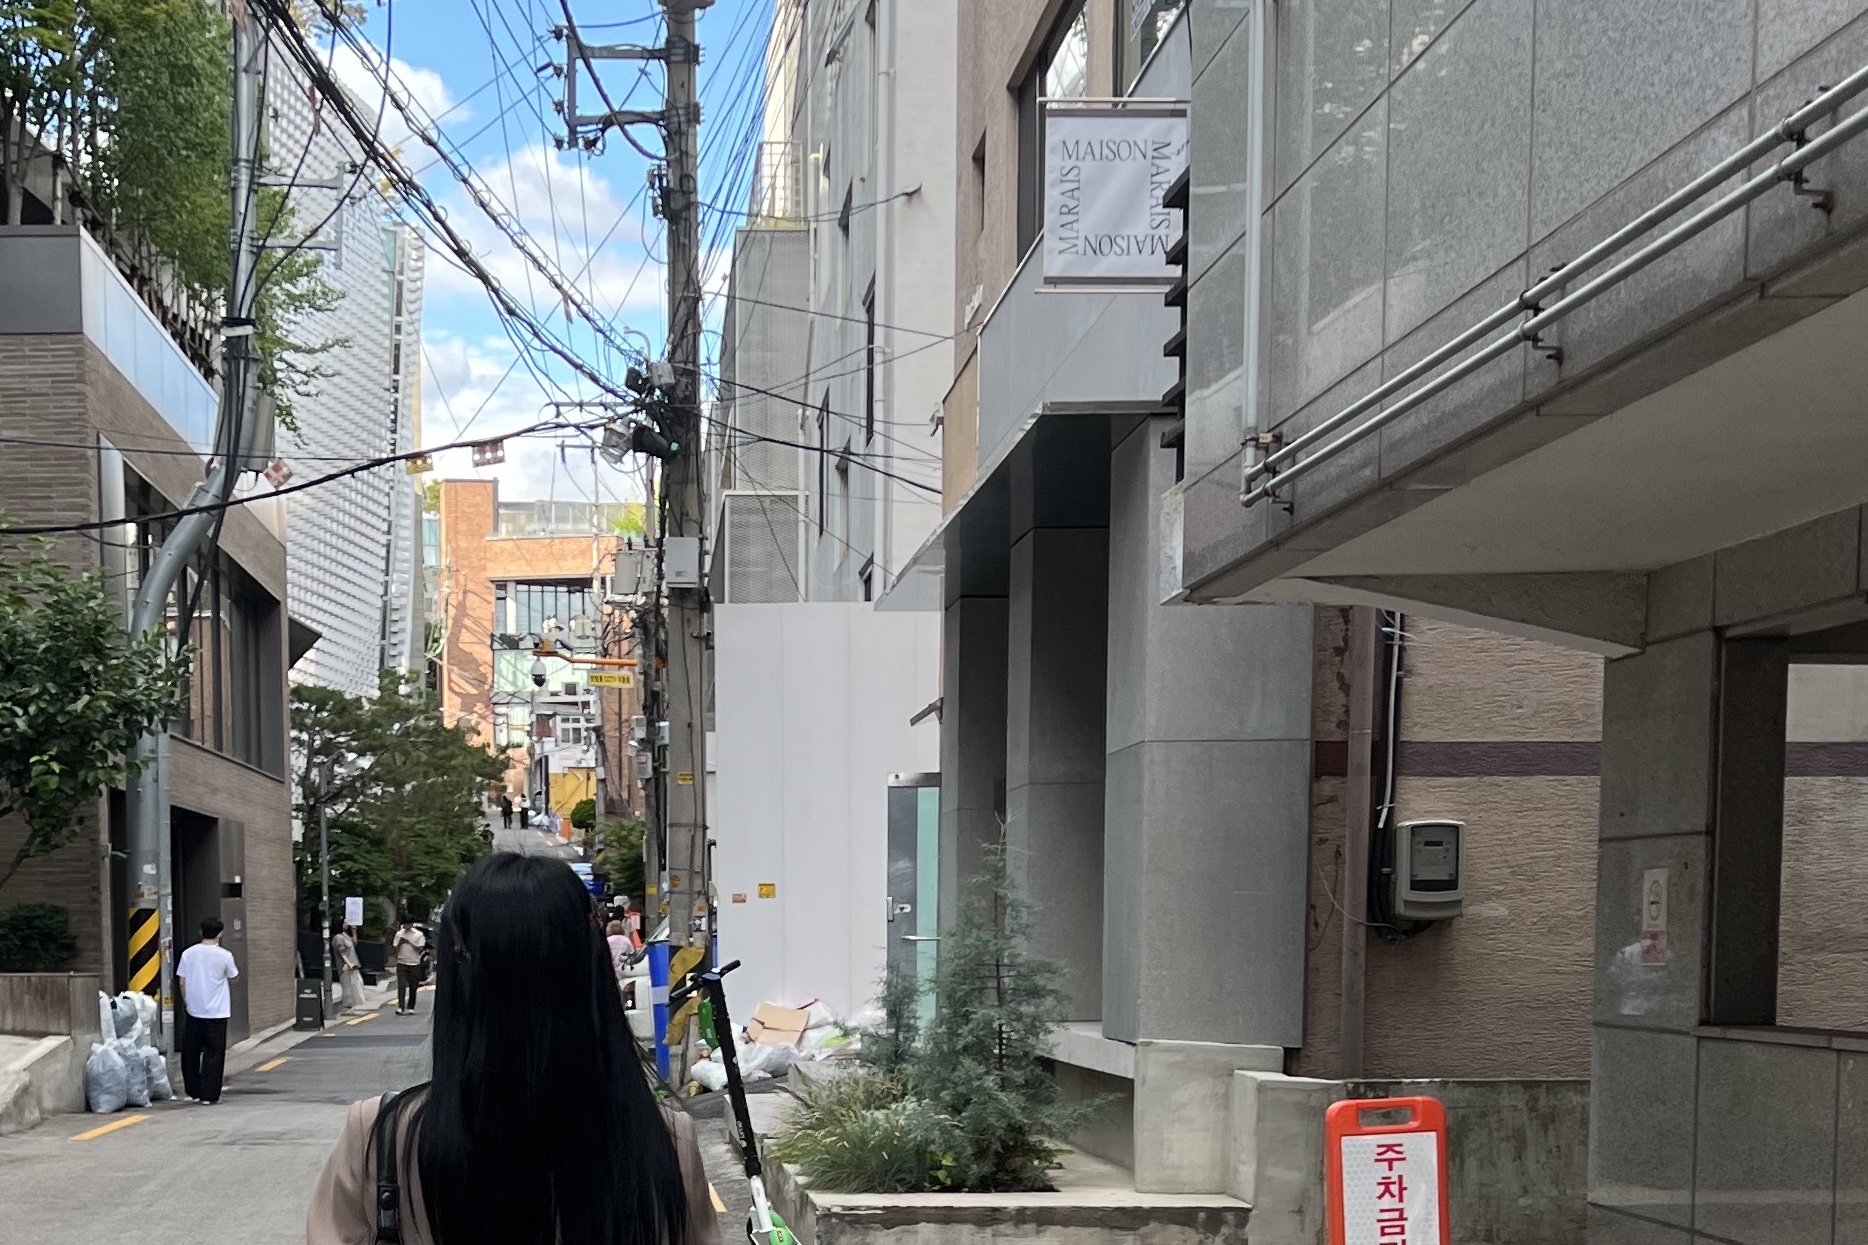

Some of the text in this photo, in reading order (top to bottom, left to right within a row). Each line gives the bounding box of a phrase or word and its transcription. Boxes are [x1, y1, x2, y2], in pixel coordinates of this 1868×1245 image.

[1062, 139, 1148, 162] MAISON
[1058, 165, 1081, 256] MARAIS
[1083, 233, 1170, 257] MAISON
